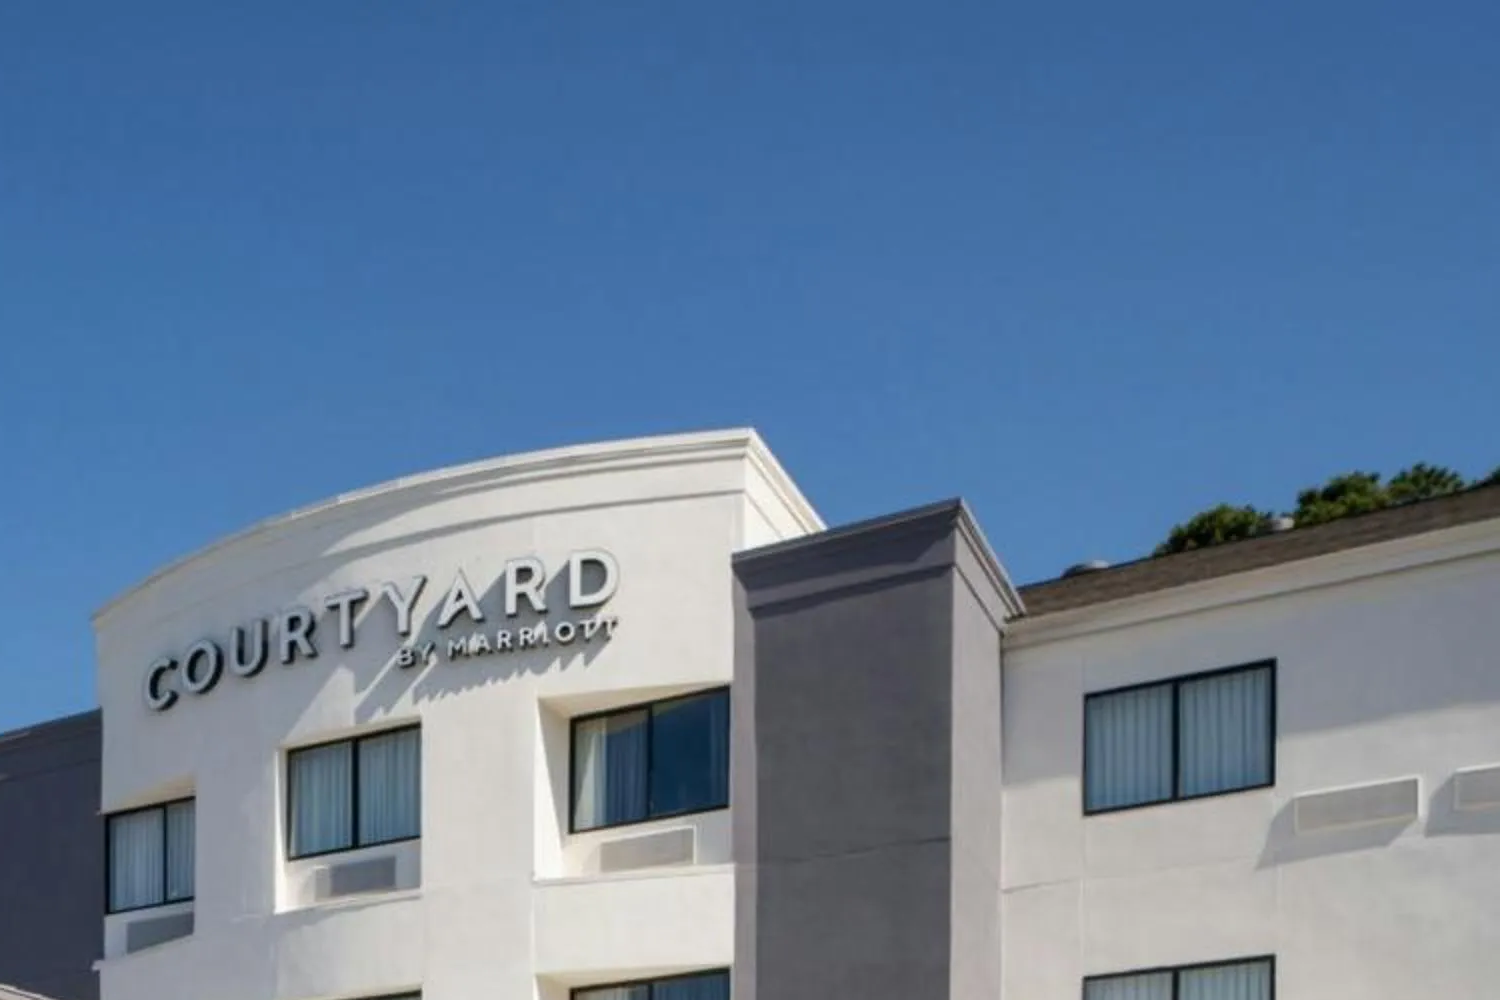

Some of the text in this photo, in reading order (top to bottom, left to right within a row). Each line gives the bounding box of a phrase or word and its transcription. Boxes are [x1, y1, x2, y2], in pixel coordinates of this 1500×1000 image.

[146, 549, 619, 711] COURTYARD
[397, 615, 617, 668] BY MARRIOTT
